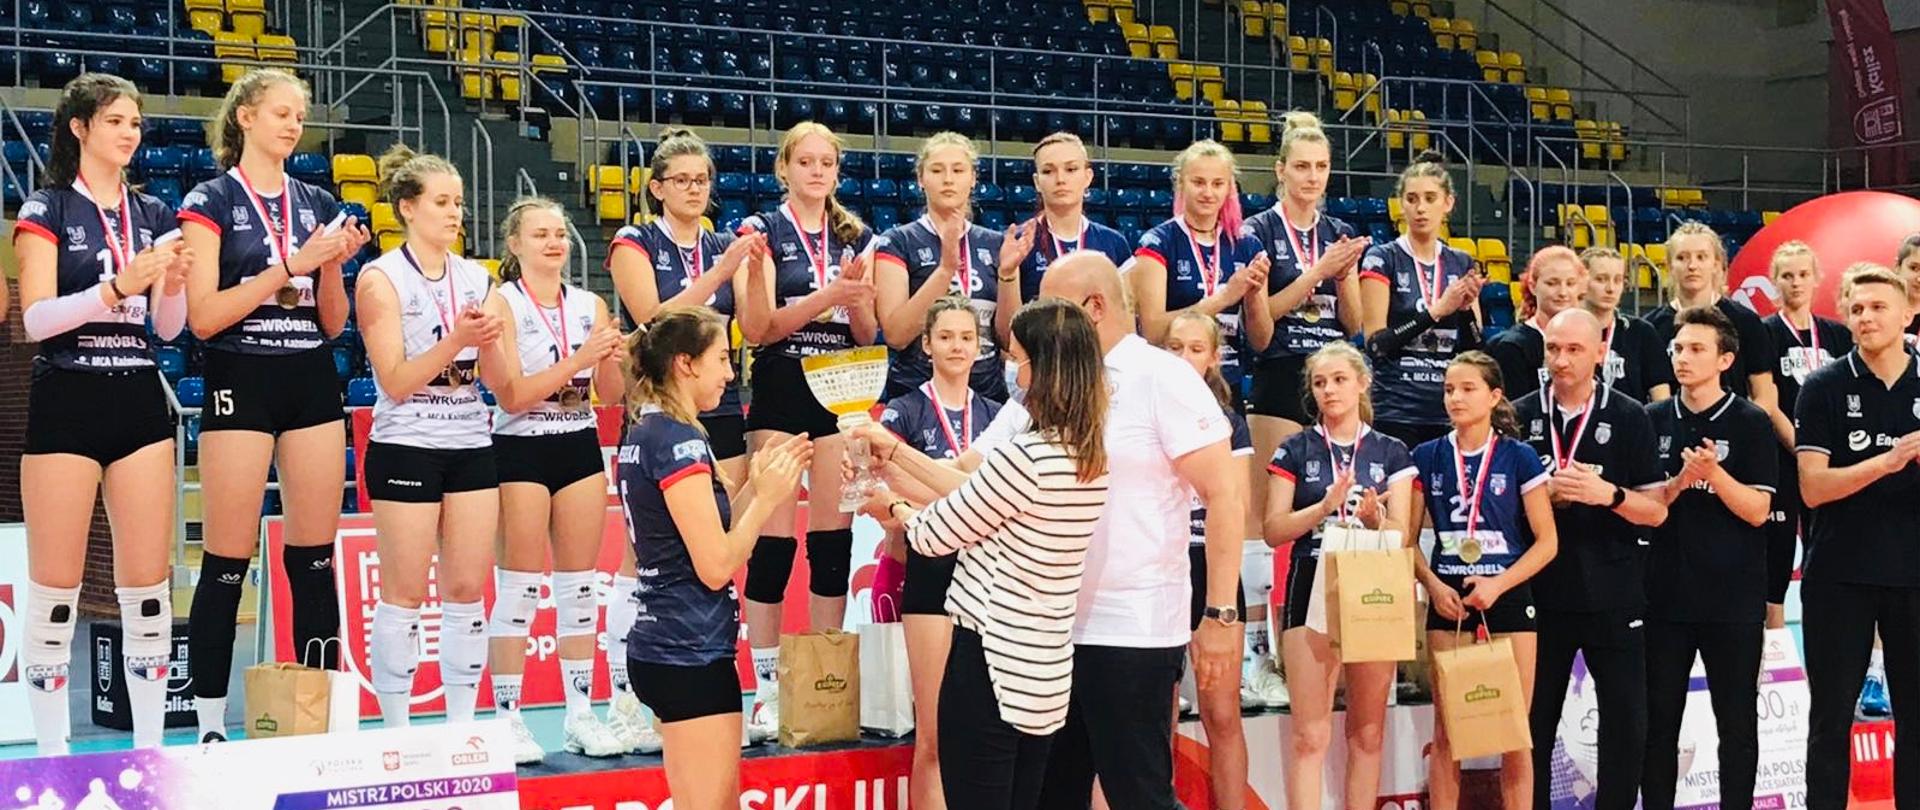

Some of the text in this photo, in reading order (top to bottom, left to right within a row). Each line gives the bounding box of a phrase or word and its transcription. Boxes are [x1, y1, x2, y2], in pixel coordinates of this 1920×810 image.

[213, 389, 234, 416] 15
[1876, 433, 1901, 447] Ene
[164, 696, 199, 712] alisz
[1772, 759, 1806, 776] POLS
[327, 775, 493, 807] MISTRZ POLSKI 2020
